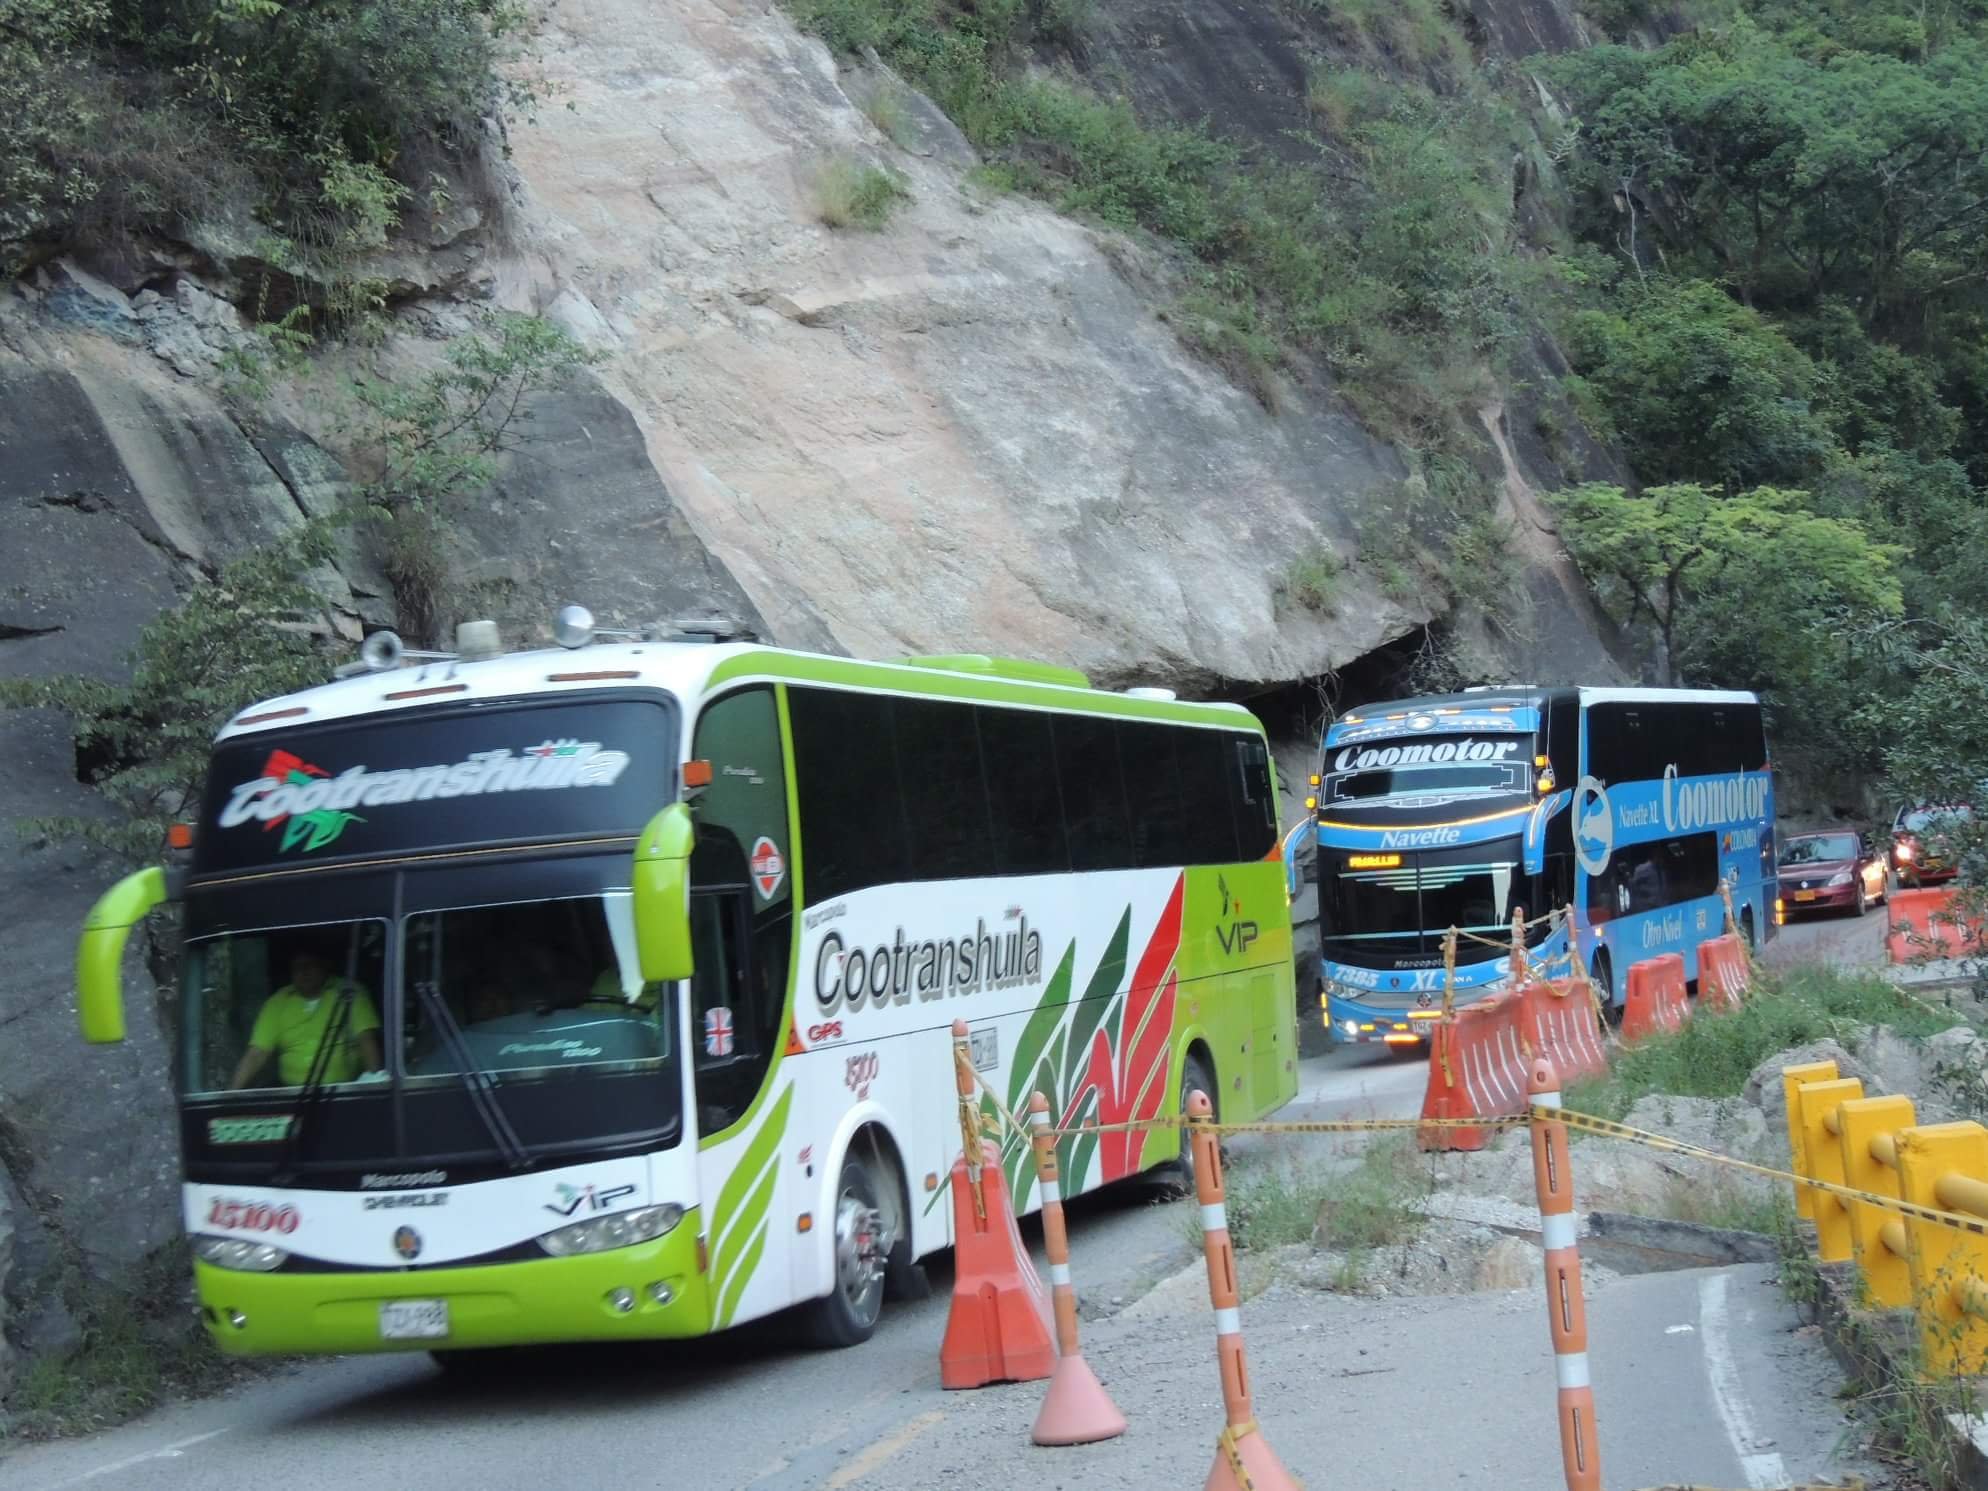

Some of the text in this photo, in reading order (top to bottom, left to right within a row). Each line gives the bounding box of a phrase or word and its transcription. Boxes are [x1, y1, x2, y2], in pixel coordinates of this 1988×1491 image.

[1334, 738, 1518, 772] Coomotor
[219, 739, 631, 829] Cootranshuila
[1663, 762, 1768, 832] Coomotor
[1380, 828, 1461, 849] Navette
[1216, 921, 1258, 955] VIP
[815, 915, 1043, 1017] Cootranshuila
[1410, 970, 1439, 991] XL
[807, 1020, 843, 1042] GPS
[543, 1184, 637, 1217] VIP
